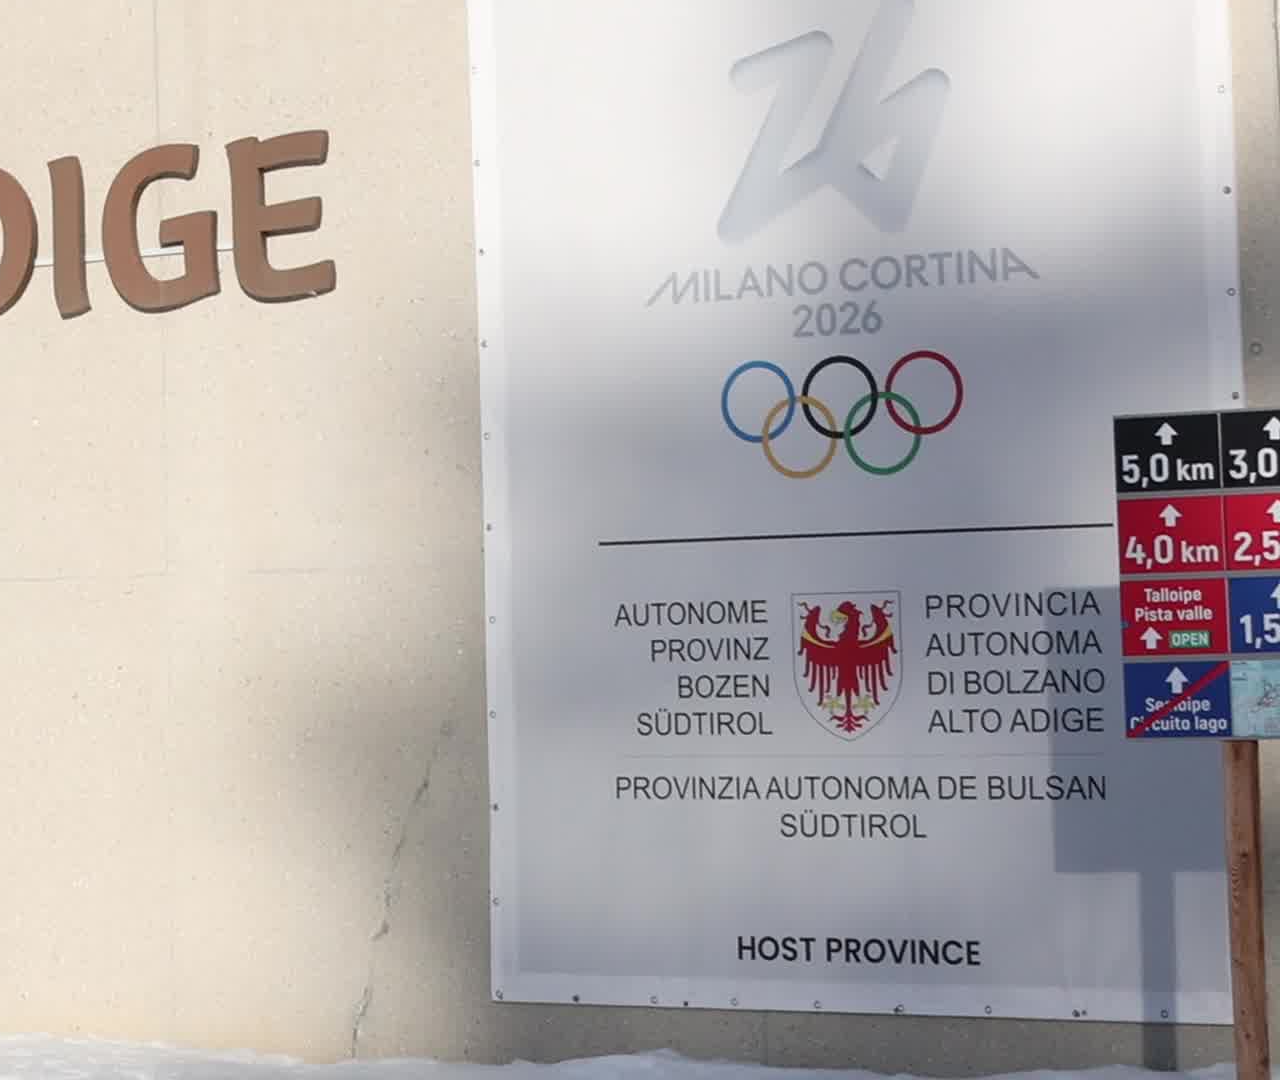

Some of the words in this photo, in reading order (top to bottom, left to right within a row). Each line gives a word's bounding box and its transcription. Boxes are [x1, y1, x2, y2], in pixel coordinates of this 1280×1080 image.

[644, 261, 828, 307] MILANO
[839, 247, 1040, 293] CORTINA
[791, 299, 883, 338] 2026
[1121, 452, 1169, 488] 5,0
[1176, 458, 1215, 482] km
[1228, 447, 1278, 484] 3,0
[1124, 534, 1174, 570] 4,0
[1180, 540, 1219, 563] km
[1233, 530, 1280, 567] 2,5
[925, 591, 1101, 619] PROVINCIA
[1144, 587, 1202, 604] Talloipe
[614, 600, 768, 627] AUTONOME
[1135, 606, 1173, 622] Pista
[1176, 605, 1213, 621] valle
[926, 630, 1103, 657] AUTONOMA
[1171, 632, 1210, 647] OPEN
[1239, 613, 1280, 649] 1,5
[650, 637, 770, 662] PROVINZ
[677, 674, 770, 699] BOZEN
[927, 671, 954, 695] DI
[964, 668, 1105, 695] BOLZANO
[637, 708, 773, 736] SÜDTIROL
[928, 709, 1002, 733] ALTO
[1009, 708, 1105, 733] ADIGE
[1194, 716, 1228, 733] lago
[615, 776, 760, 800] PROVINZIA
[766, 776, 930, 800] AUTONOMA
[938, 776, 977, 800] DE
[987, 776, 1106, 800] BULSAN
[780, 809, 927, 838] SÜDTIROL
[738, 936, 816, 962] HOST
[826, 937, 981, 966] PROVINCE
